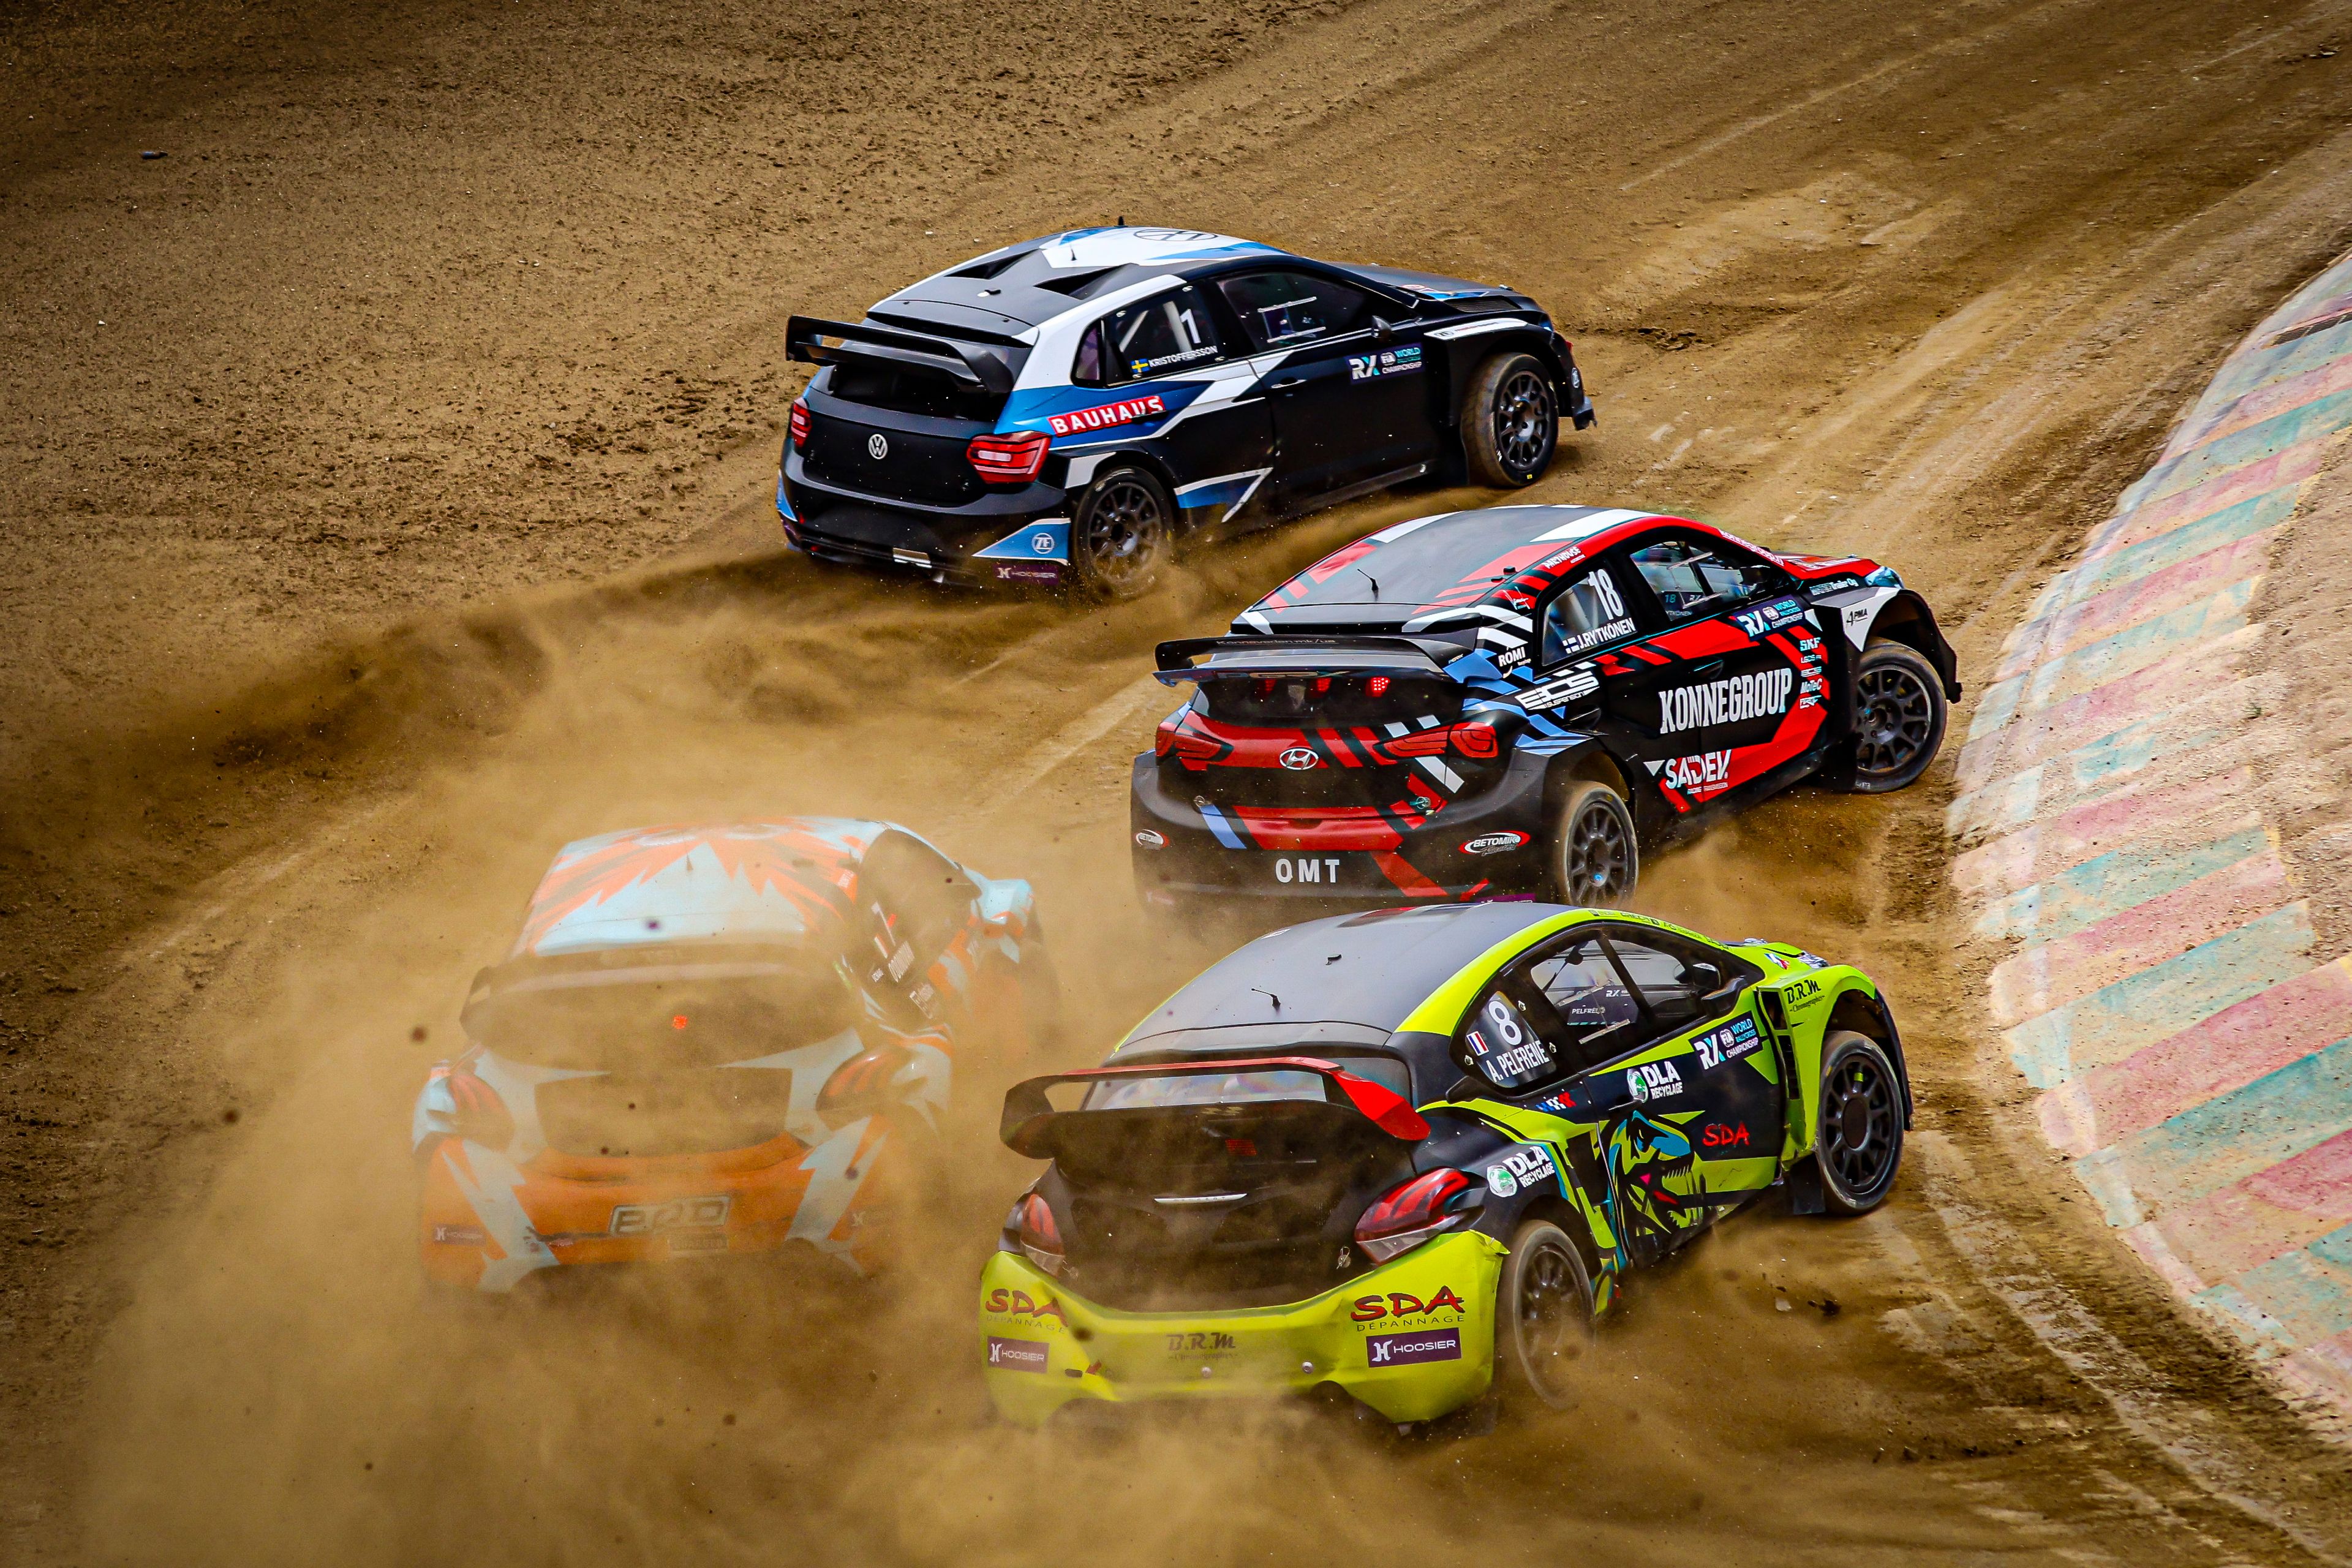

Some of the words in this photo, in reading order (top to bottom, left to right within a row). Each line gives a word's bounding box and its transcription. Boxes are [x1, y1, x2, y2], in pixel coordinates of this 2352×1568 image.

[1180, 309, 1201, 344] 1
[1148, 345, 1218, 367] KRISTOFFERSSON
[1349, 355, 1380, 379] RX
[1394, 347, 1420, 357] WORLD
[1051, 399, 1163, 433] BAUHAUS
[1588, 568, 1624, 620] 18
[1665, 594, 1676, 603] 18
[1737, 610, 1771, 637] RX
[1800, 637, 1821, 651] SKF
[1658, 668, 1793, 734] KONNEGROUP
[1665, 749, 1732, 789] SADEV
[1275, 859, 1340, 883] OMT
[1488, 1000, 1522, 1045] 8
[1694, 1034, 1726, 1070] RX
[1731, 1019, 1753, 1035] WORLD
[1727, 1037, 1758, 1058] CHAMPIONSHIP
[1486, 1060, 1504, 1082] A.
[1496, 1040, 1550, 1077] PELFRENE
[1640, 1061, 1681, 1088] DLA
[1650, 1082, 1683, 1099] RECYCLAGE
[1703, 1120, 1750, 1147] SDA
[1502, 1146, 1550, 1177] DLA
[1518, 1162, 1555, 1188] RECYCLAGE
[1351, 1285, 1466, 1322] SDA
[1356, 1316, 1465, 1332] DÉPANNAGE
[1002, 1349, 1045, 1362] HOOSIER
[1393, 1340, 1456, 1354] HOOSIER
